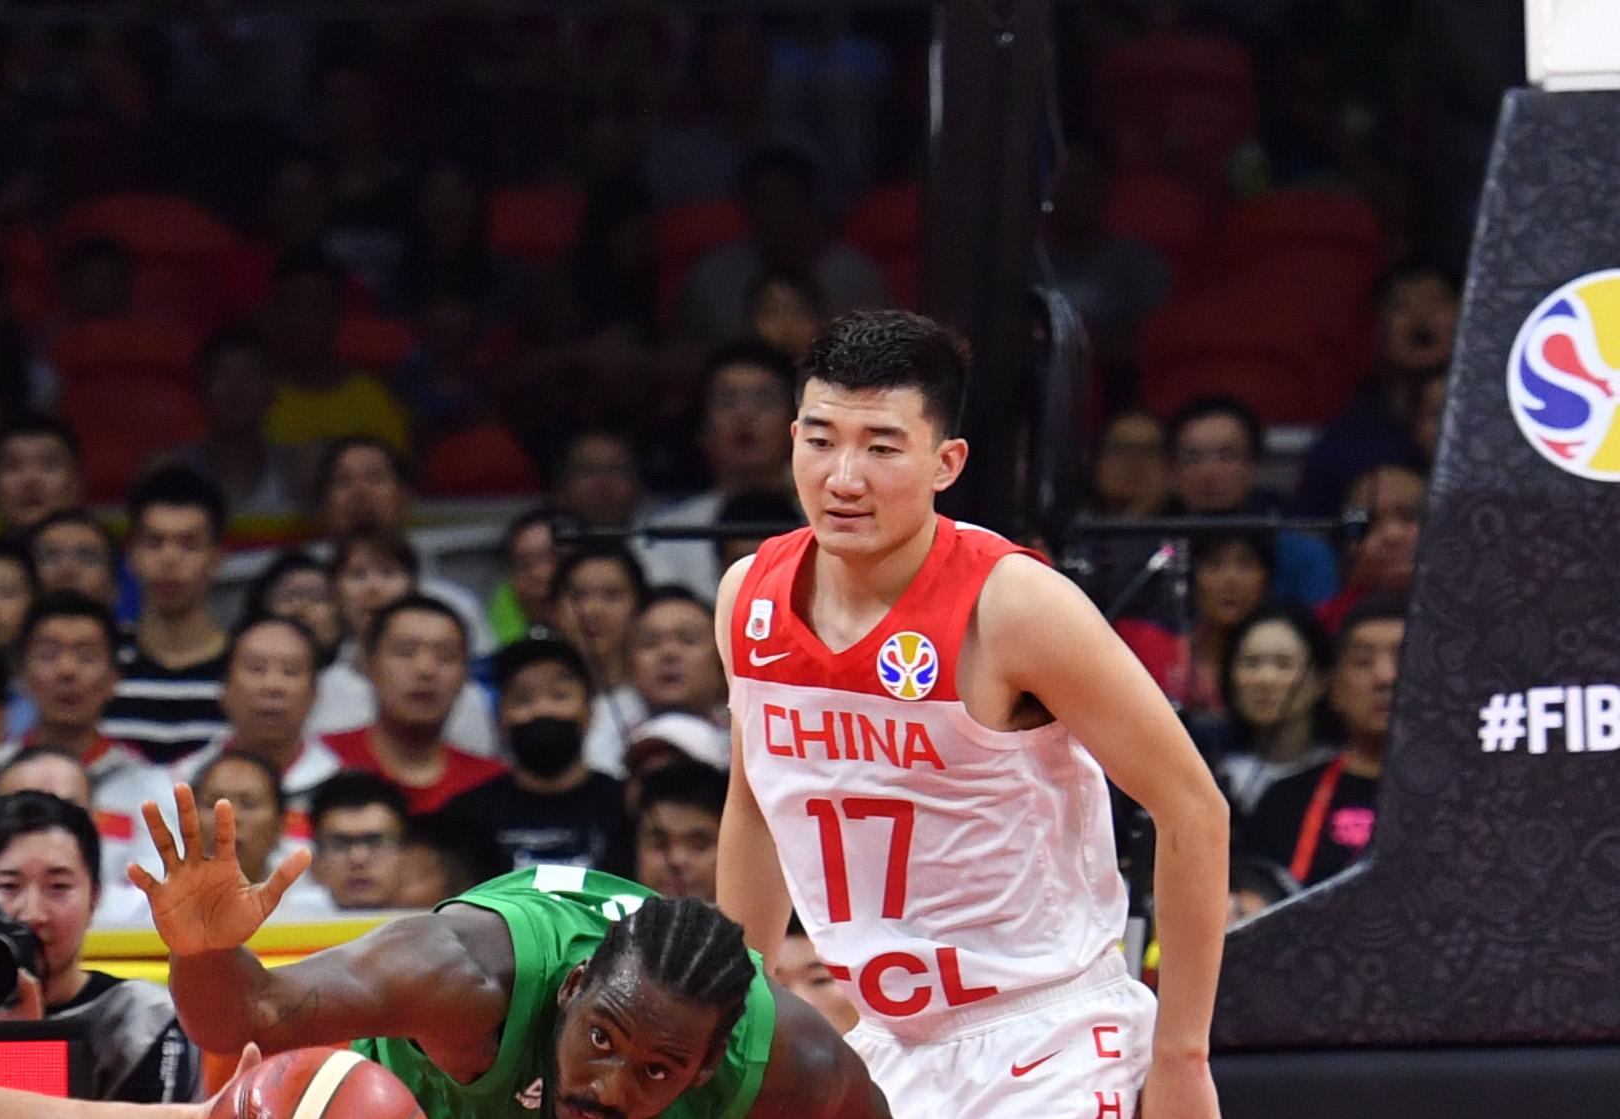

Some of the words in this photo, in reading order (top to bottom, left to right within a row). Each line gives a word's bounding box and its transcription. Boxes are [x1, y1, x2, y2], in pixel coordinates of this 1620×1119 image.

[764, 704, 946, 770] CHINA
[806, 797, 915, 923] 17
[826, 946, 999, 1018] CL
